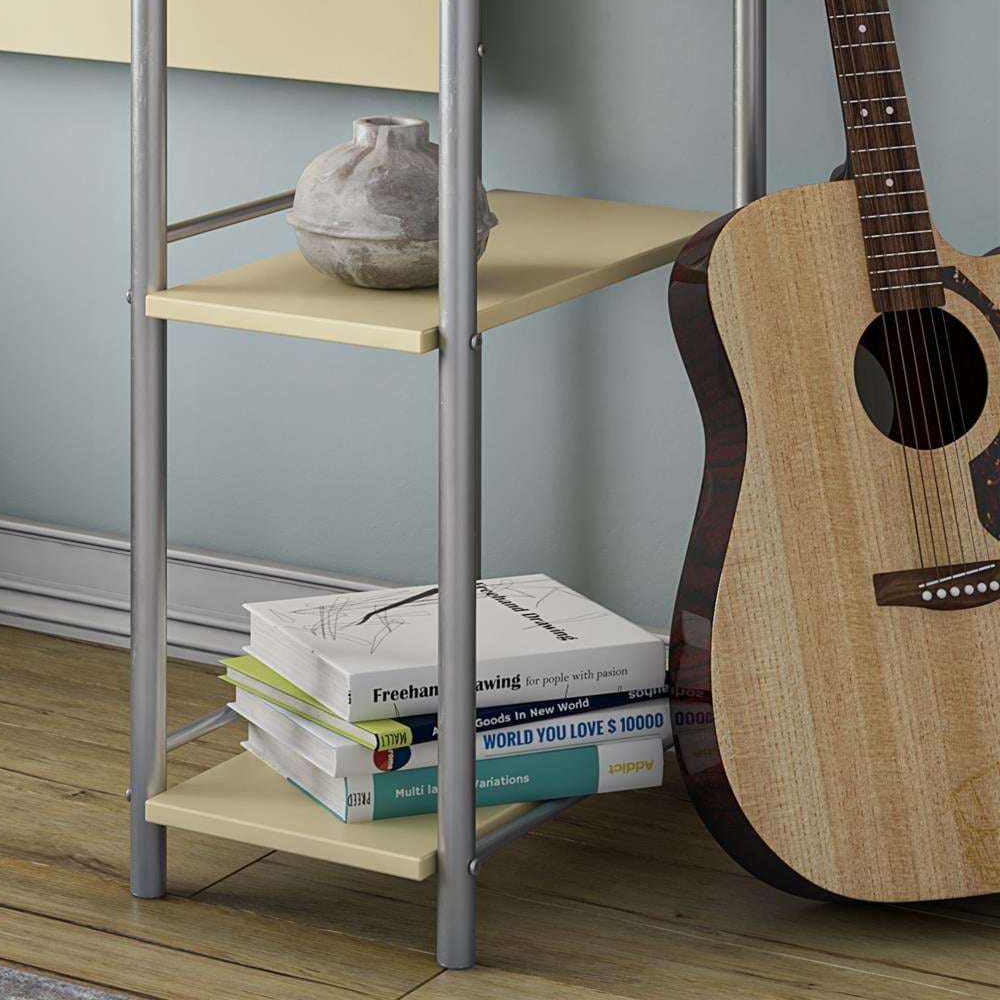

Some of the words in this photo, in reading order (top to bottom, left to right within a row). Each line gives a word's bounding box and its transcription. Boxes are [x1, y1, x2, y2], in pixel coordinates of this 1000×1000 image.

[522, 609, 579, 641] Drawing
[373, 683, 438, 703] Freehan
[525, 675, 540, 687] for
[542, 672, 569, 687] pople
[596, 666, 628, 681] pasion
[475, 711, 511, 729] Goods
[515, 709, 527, 720] In
[529, 703, 555, 719] New
[557, 697, 590, 713] World
[483, 730, 533, 750] WORLD
[538, 724, 567, 744] YOU
[570, 719, 604, 738] LOVE
[606, 717, 617, 734] $
[619, 712, 664, 732] 10000
[607, 759, 655, 775] Addict
[395, 785, 425, 798] Multi
